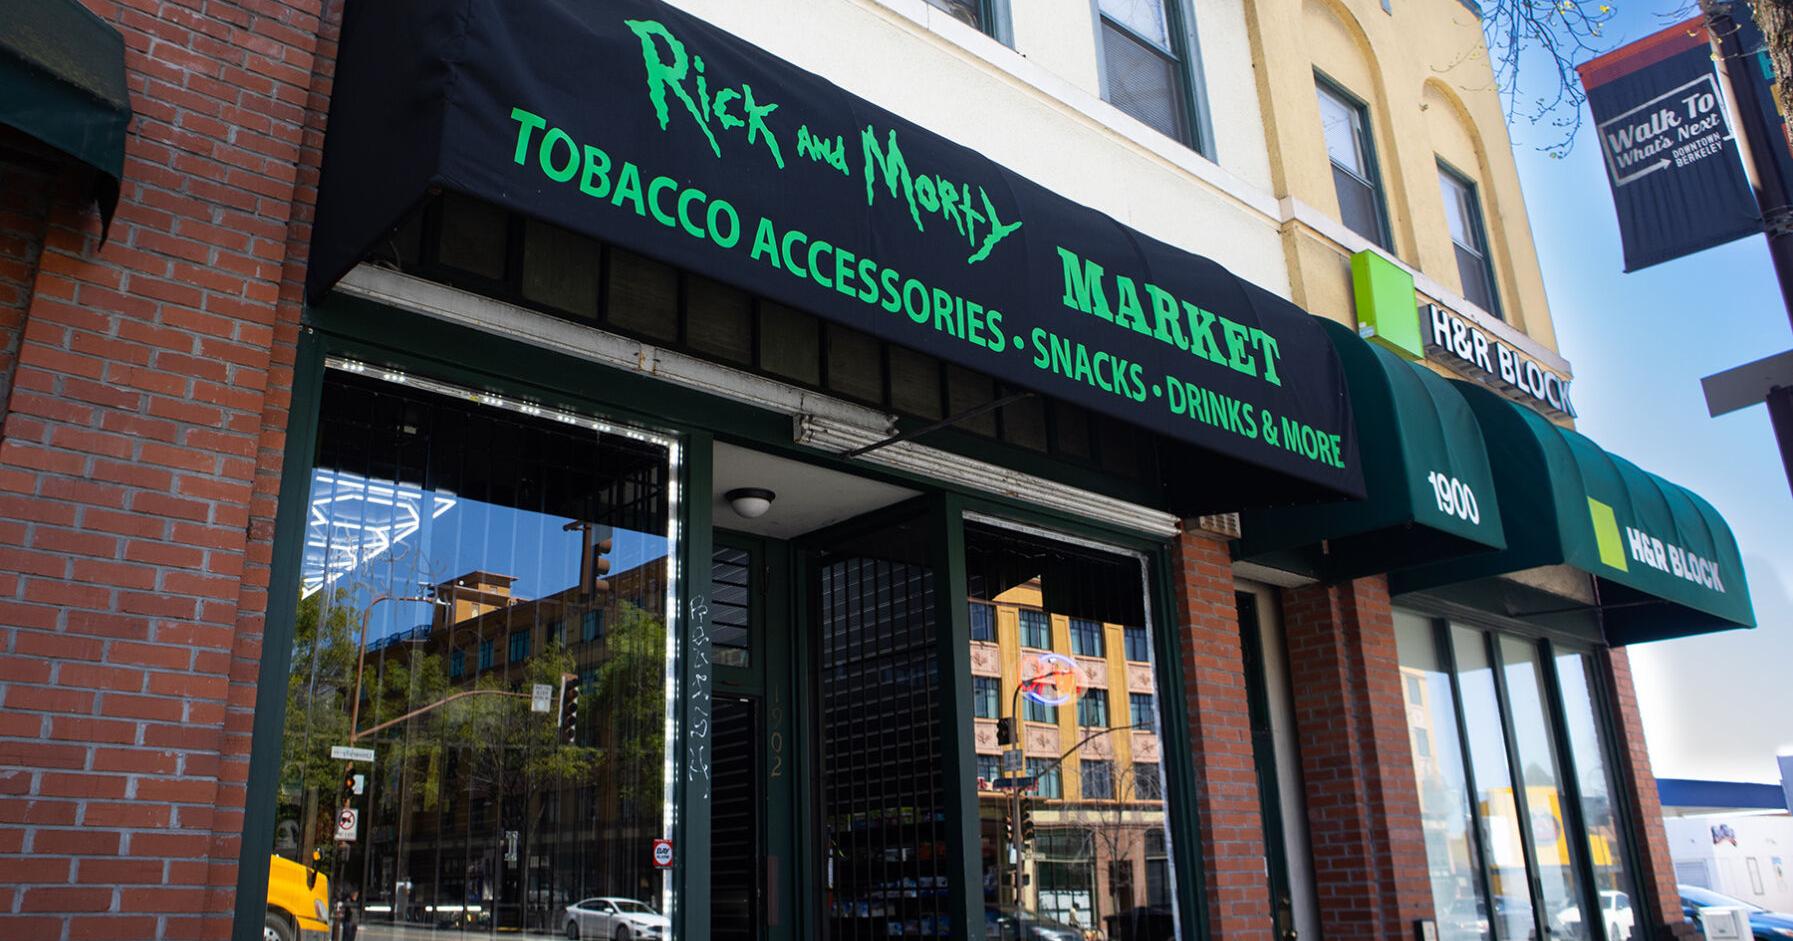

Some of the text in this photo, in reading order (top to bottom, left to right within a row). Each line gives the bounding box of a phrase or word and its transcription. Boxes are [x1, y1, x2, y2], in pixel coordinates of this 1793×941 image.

[1608, 93, 1715, 154] Walk To
[1616, 113, 1720, 169] What's Next
[1671, 131, 1721, 159] DOWNTOWN
[1675, 140, 1723, 168] BERKELEY
[511, 107, 1346, 469] TOBACCO ACCESSORIES SNACKS DRINKS & MORE
[1056, 246, 1282, 386] MARKET
[1429, 303, 1578, 419] H&R BLOCK
[1427, 471, 1481, 526] 1900
[1625, 526, 1726, 594] H&R BLOCK
